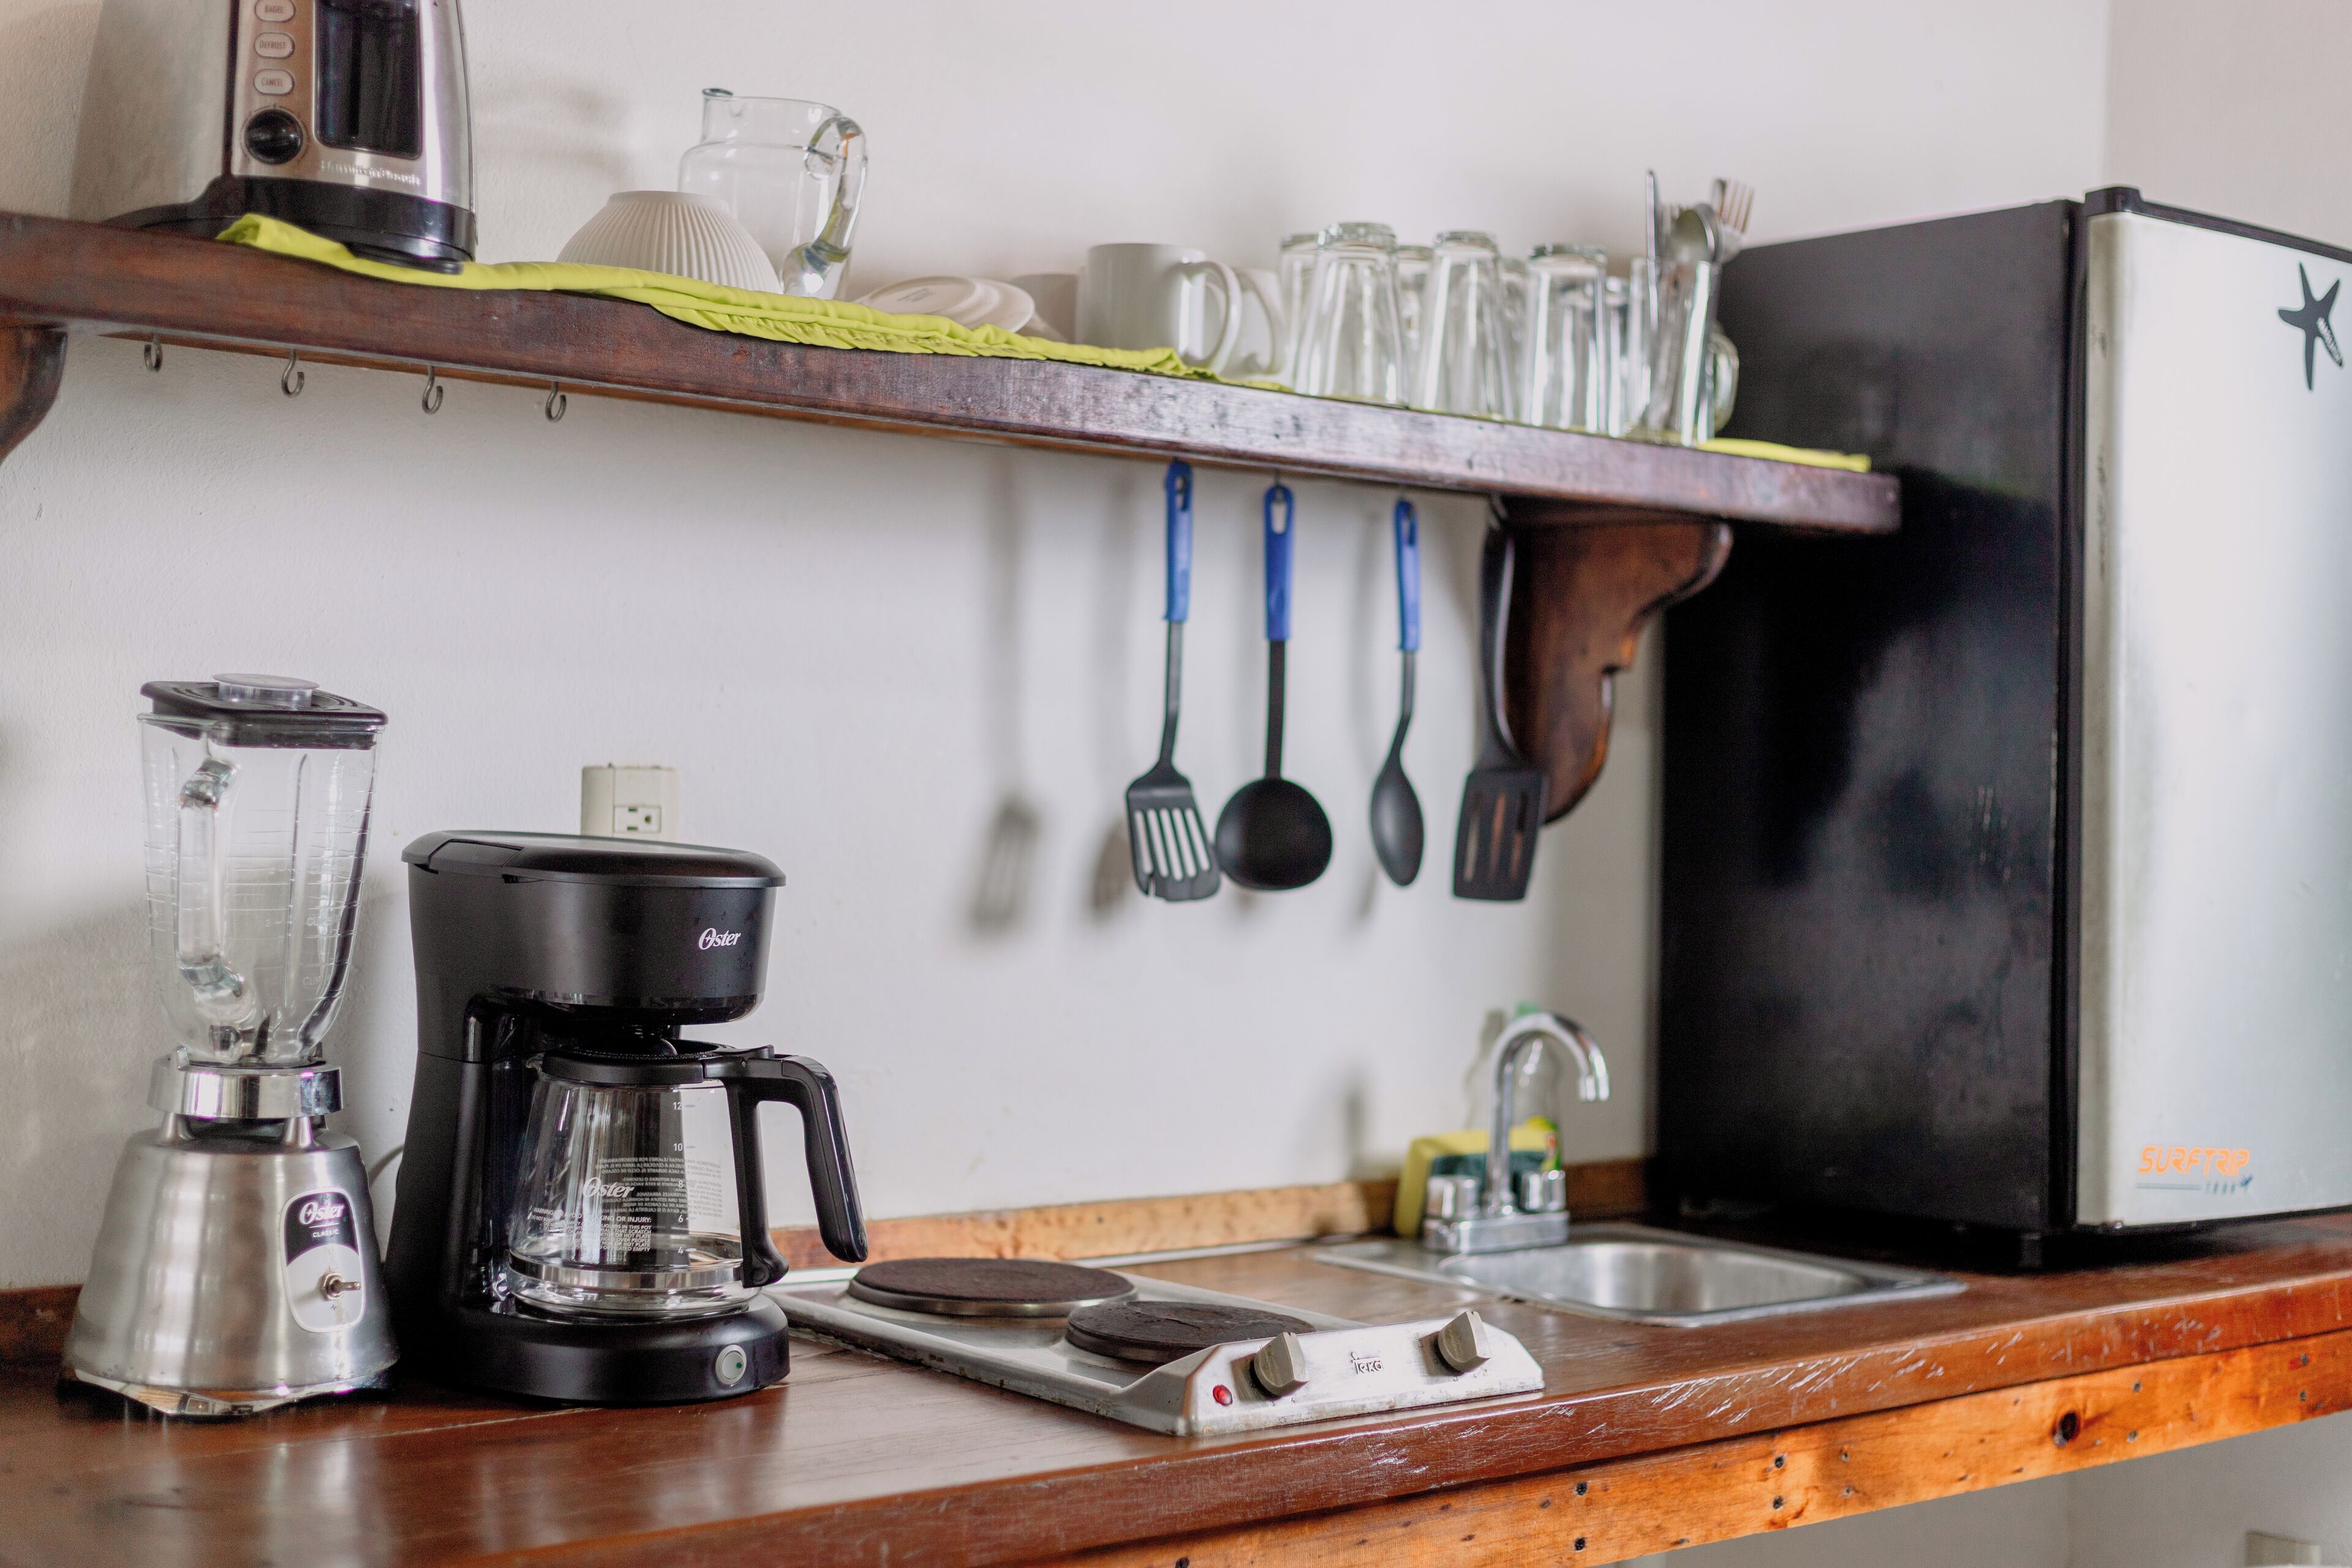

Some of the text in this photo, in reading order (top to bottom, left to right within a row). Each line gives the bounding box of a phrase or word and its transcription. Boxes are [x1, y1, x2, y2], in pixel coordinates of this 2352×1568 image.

[259, 40, 285, 50] DEFROST
[262, 77, 284, 87] CANCEL
[699, 928, 741, 950] Oster
[673, 1102, 682, 1110] 12
[673, 1143, 683, 1152] 10
[2138, 1147, 2250, 1176] SURFTRIP
[582, 1177, 635, 1197] Oster
[300, 1202, 344, 1225] Oster
[534, 1207, 554, 1216] WARNING
[312, 1229, 339, 1238] CLASSIC
[678, 1246, 684, 1254] 4
